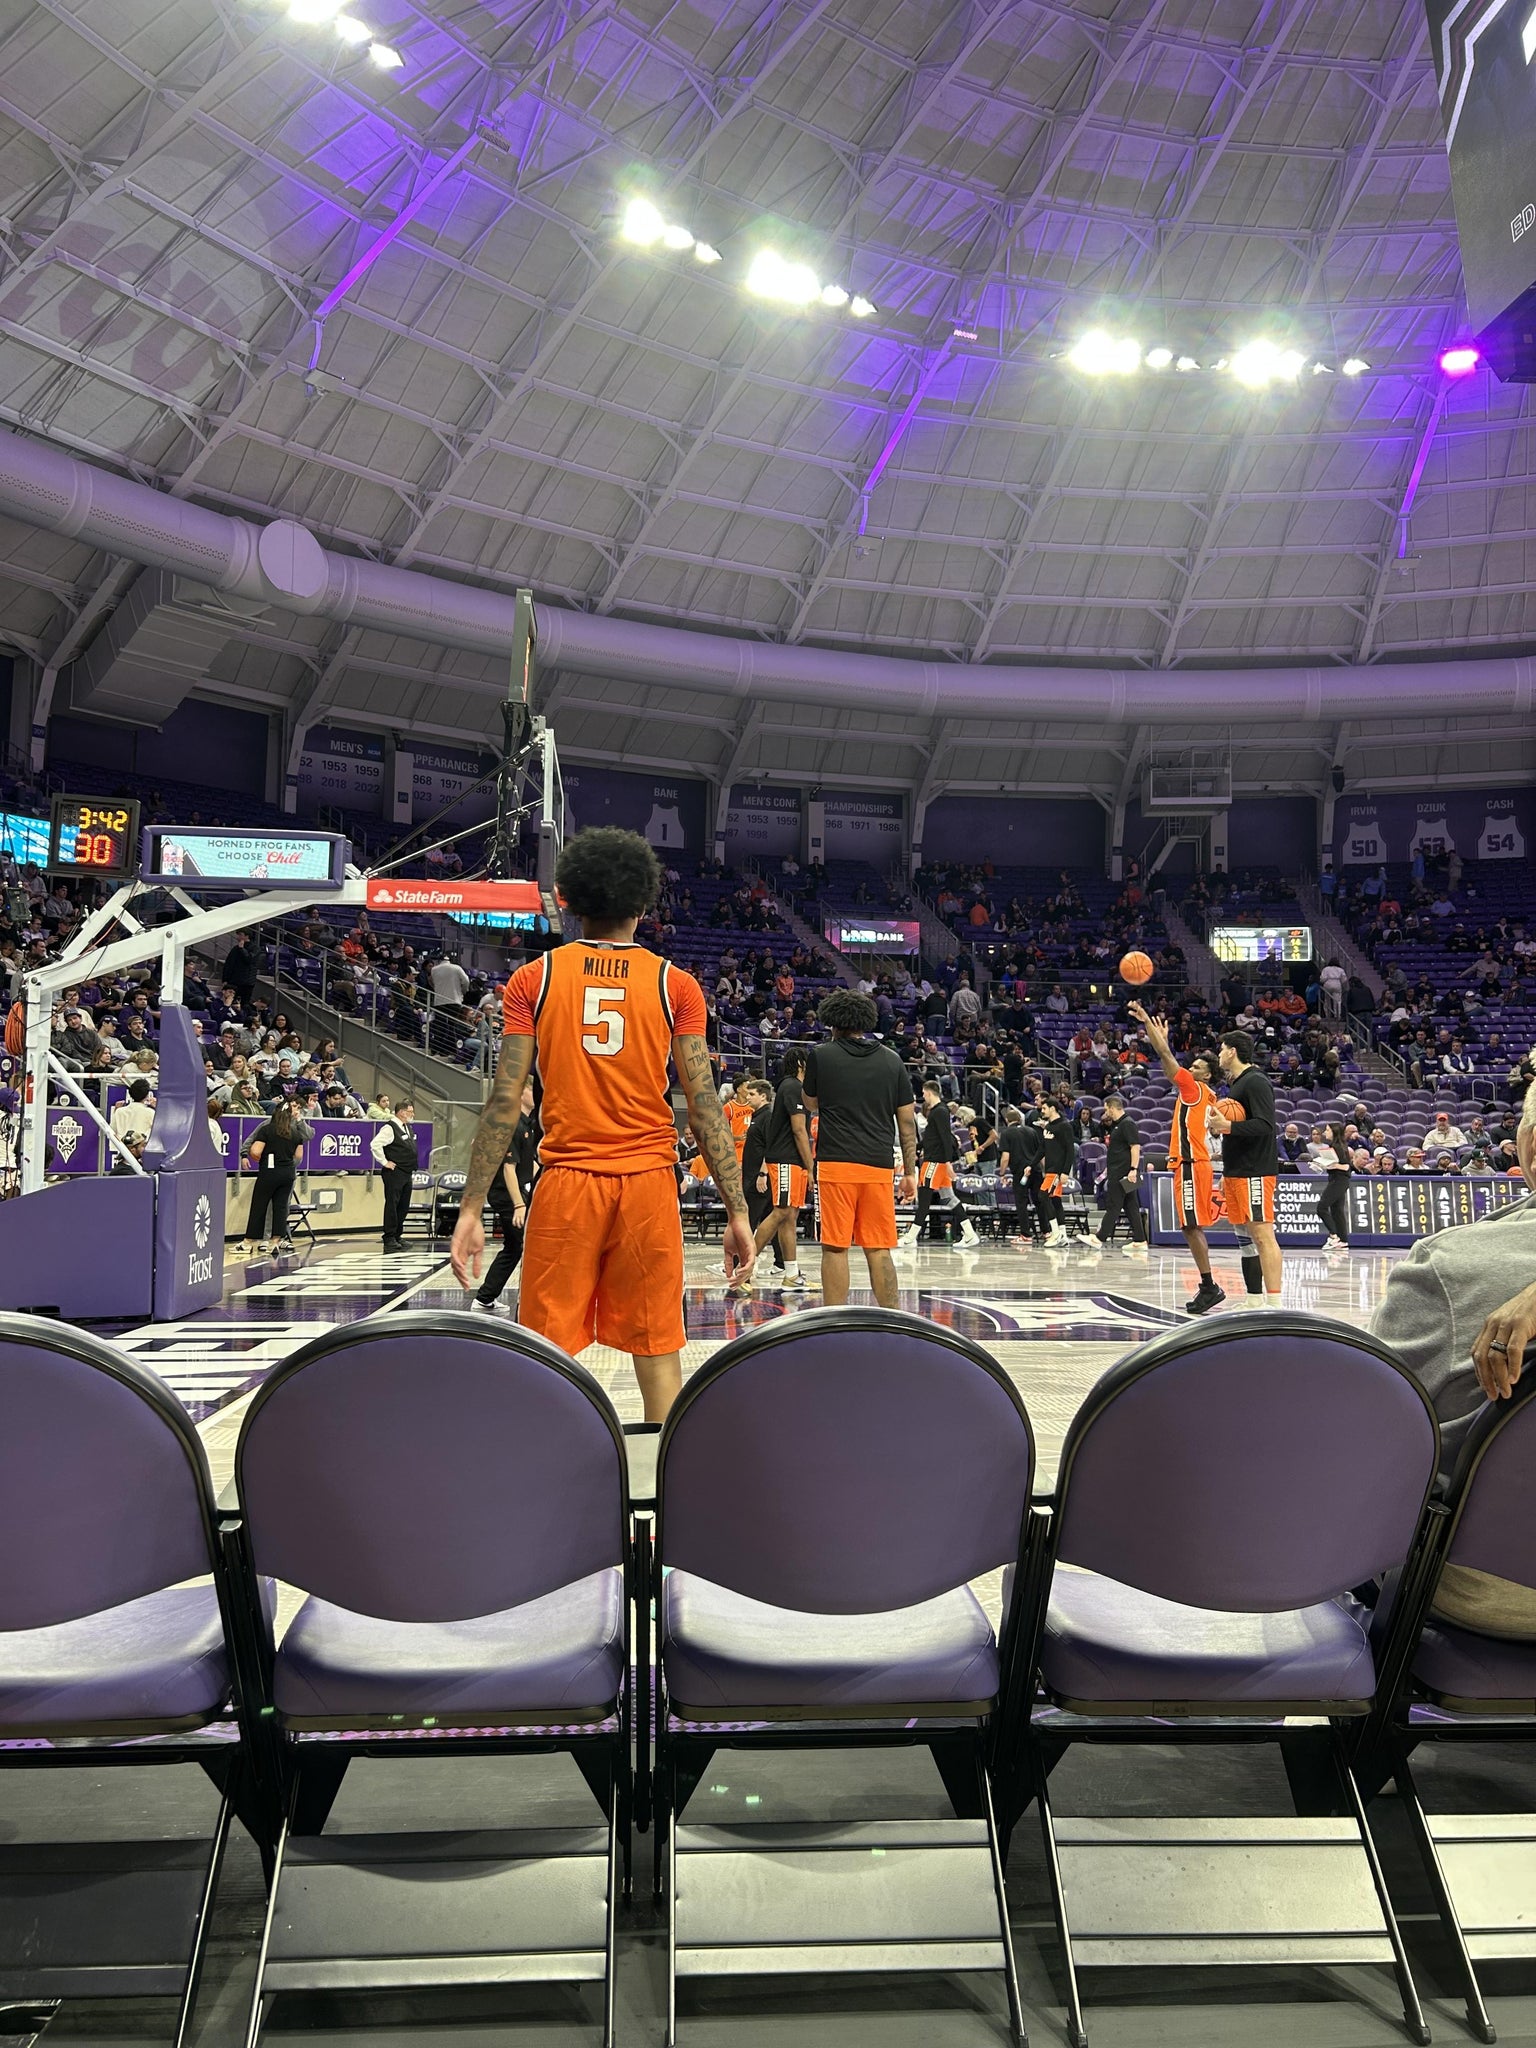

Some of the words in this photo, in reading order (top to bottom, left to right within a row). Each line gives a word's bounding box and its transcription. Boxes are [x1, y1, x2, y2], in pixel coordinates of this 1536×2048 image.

[1510, 203, 1536, 243] ED
[330, 740, 364, 755] MEN'S
[300, 756, 313, 768] 52
[321, 760, 348, 773] 1953
[354, 765, 380, 777] 1959
[298, 773, 313, 785] 98
[321, 776, 348, 789] 2018
[354, 782, 380, 794] 2022
[412, 774, 432, 786] 968
[440, 778, 463, 790] 1971
[413, 790, 432, 802] 023
[654, 787, 678, 799] BANE
[742, 796, 771, 807] MEN'S
[1486, 799, 1514, 810] CASH
[1350, 806, 1377, 816] IRVIN
[1416, 802, 1446, 813] DZIUK
[79, 807, 128, 832] 3:42
[727, 812, 740, 823] 52
[746, 814, 769, 825] 1953
[776, 816, 798, 826] 1959
[825, 819, 843, 829] 968
[850, 820, 870, 831] 1971
[878, 822, 900, 832] 1986
[662, 823, 668, 840] 1
[727, 828, 739, 838] 87
[75, 832, 112, 865] 30
[207, 839, 252, 850] HORNED
[254, 840, 283, 851] FROG
[285, 842, 314, 853] FANS,
[1352, 839, 1378, 857] 50
[1487, 834, 1515, 852] 54
[217, 851, 263, 862] CHOOSE
[266, 851, 304, 864] Chill
[583, 956, 630, 978] MILLER
[581, 986, 626, 1056] 5
[53, 1126, 66, 1134] FROG
[67, 1126, 81, 1135] ARMY
[338, 1134, 362, 1146] TACO
[338, 1146, 362, 1156] BELL
[444, 1174, 468, 1185] TCU
[960, 1177, 982, 1188] TCU
[1278, 1182, 1312, 1192] CURRY
[1376, 1183, 1384, 1193] 9
[1418, 1183, 1424, 1193] 1
[1459, 1184, 1467, 1193] 3
[1499, 1184, 1506, 1193] 3
[1184, 1179, 1193, 1210] COWBOYS
[1279, 1193, 1321, 1202] COLEMA
[1377, 1194, 1385, 1203] 4
[1418, 1194, 1425, 1204] 0
[1460, 1195, 1468, 1204] 2
[1280, 1203, 1302, 1212] ROY
[1378, 1204, 1385, 1213] 9
[1419, 1204, 1425, 1214] 1
[1460, 1204, 1468, 1214] 0
[1379, 1214, 1386, 1224] 4
[1419, 1214, 1427, 1224] 0
[1462, 1215, 1468, 1224] 1
[1281, 1224, 1320, 1233] FALLAH
[1379, 1224, 1387, 1234] 2
[1422, 1225, 1426, 1234] 1
[188, 1252, 213, 1286] Frost
